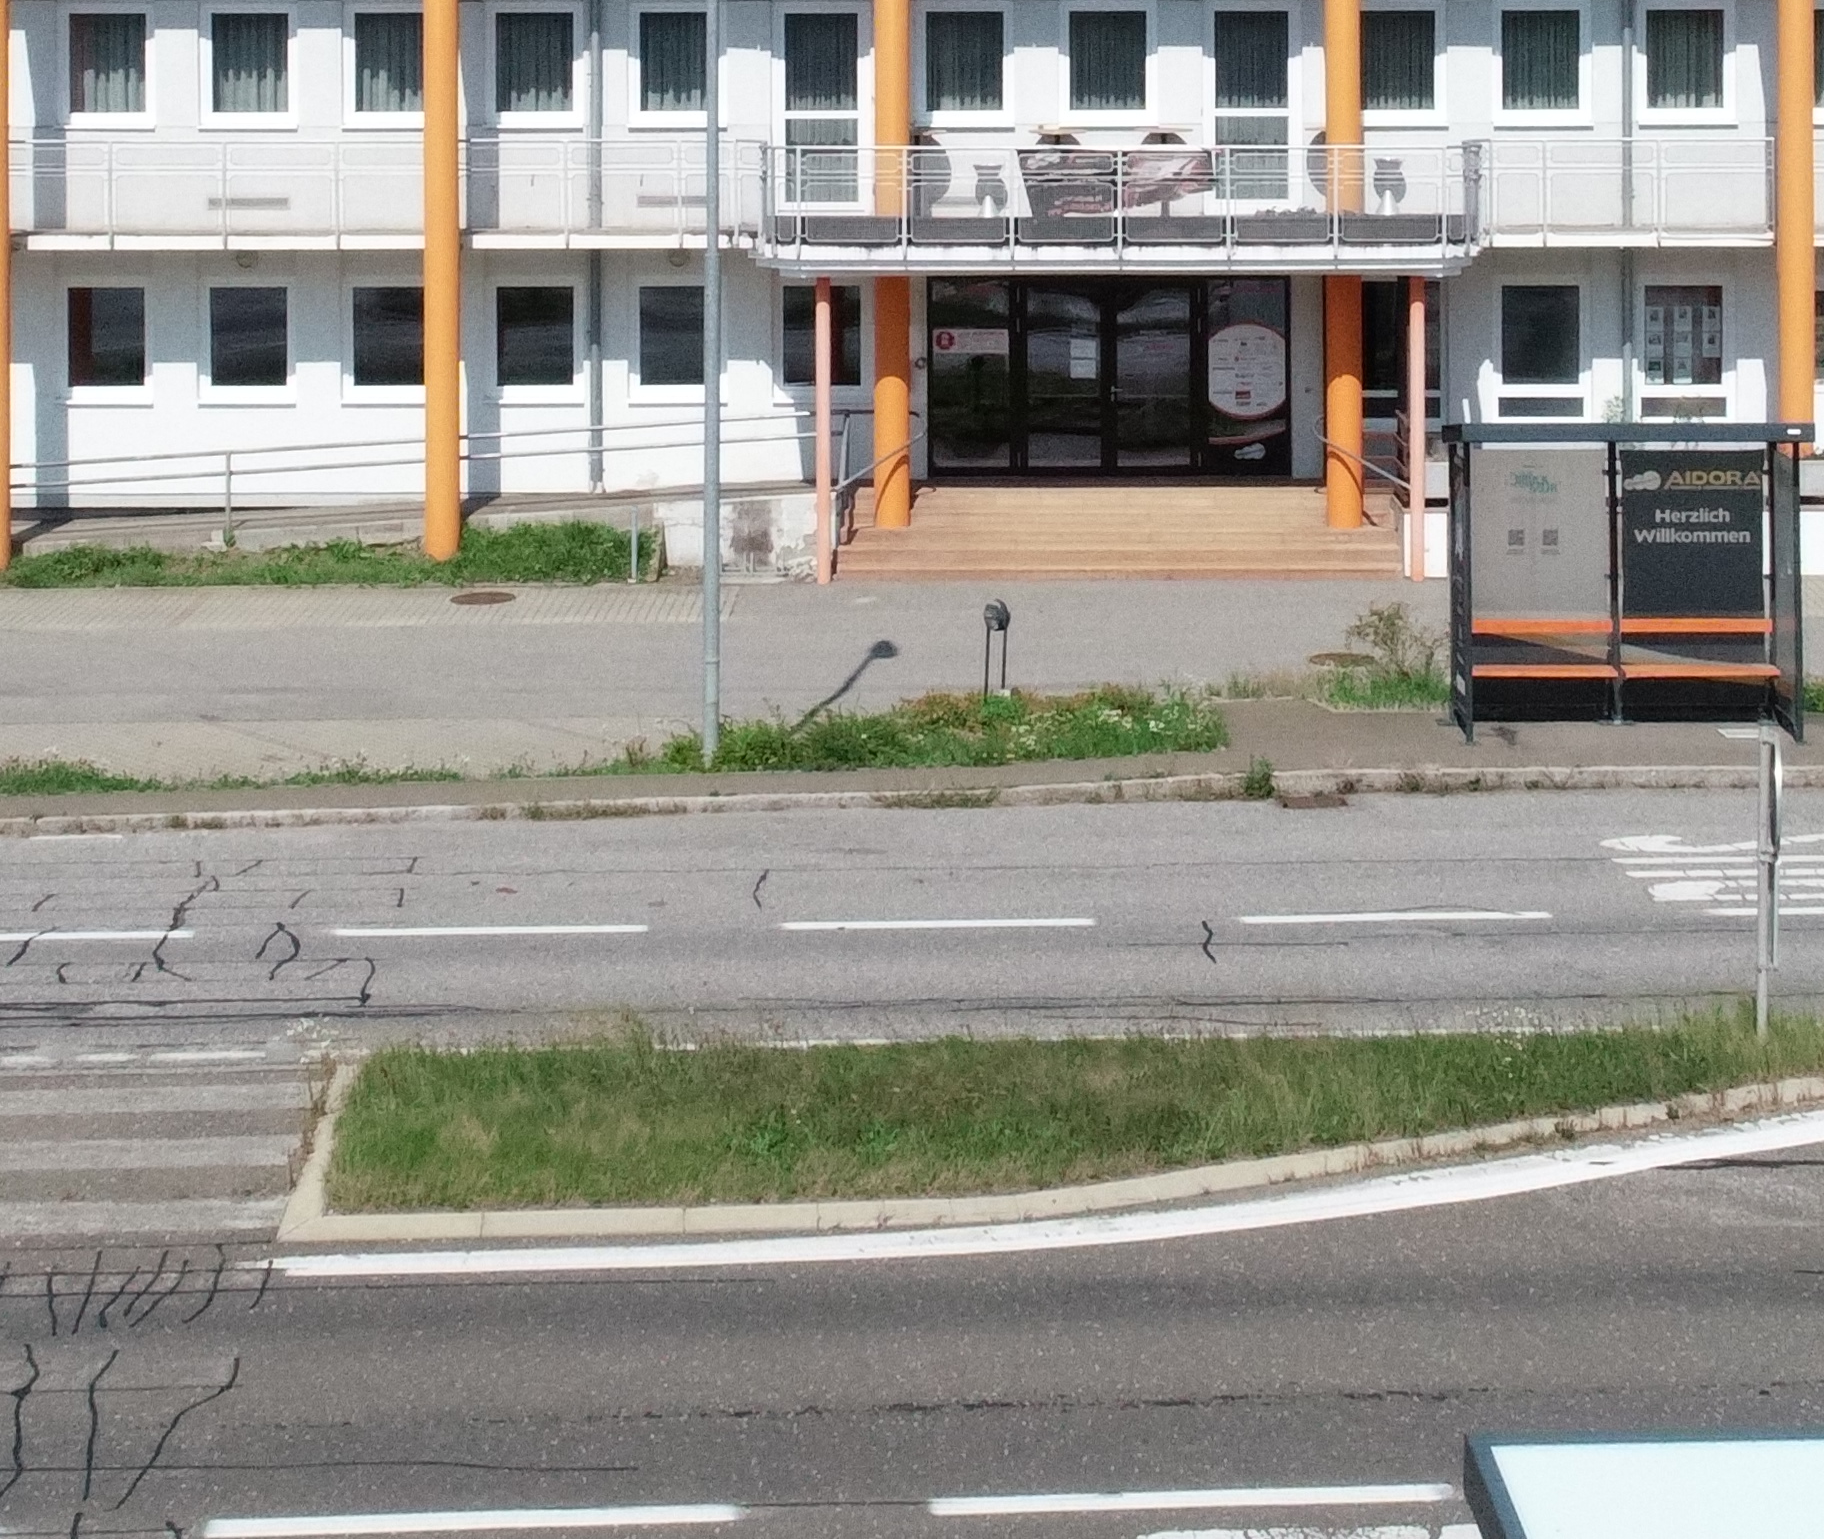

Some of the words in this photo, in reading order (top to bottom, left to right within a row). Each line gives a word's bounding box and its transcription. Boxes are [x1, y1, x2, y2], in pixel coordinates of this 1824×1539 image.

[1663, 470, 1761, 490] AIDORA
[1655, 508, 1731, 523] Herzlich
[1634, 528, 1751, 543] Willkommen
